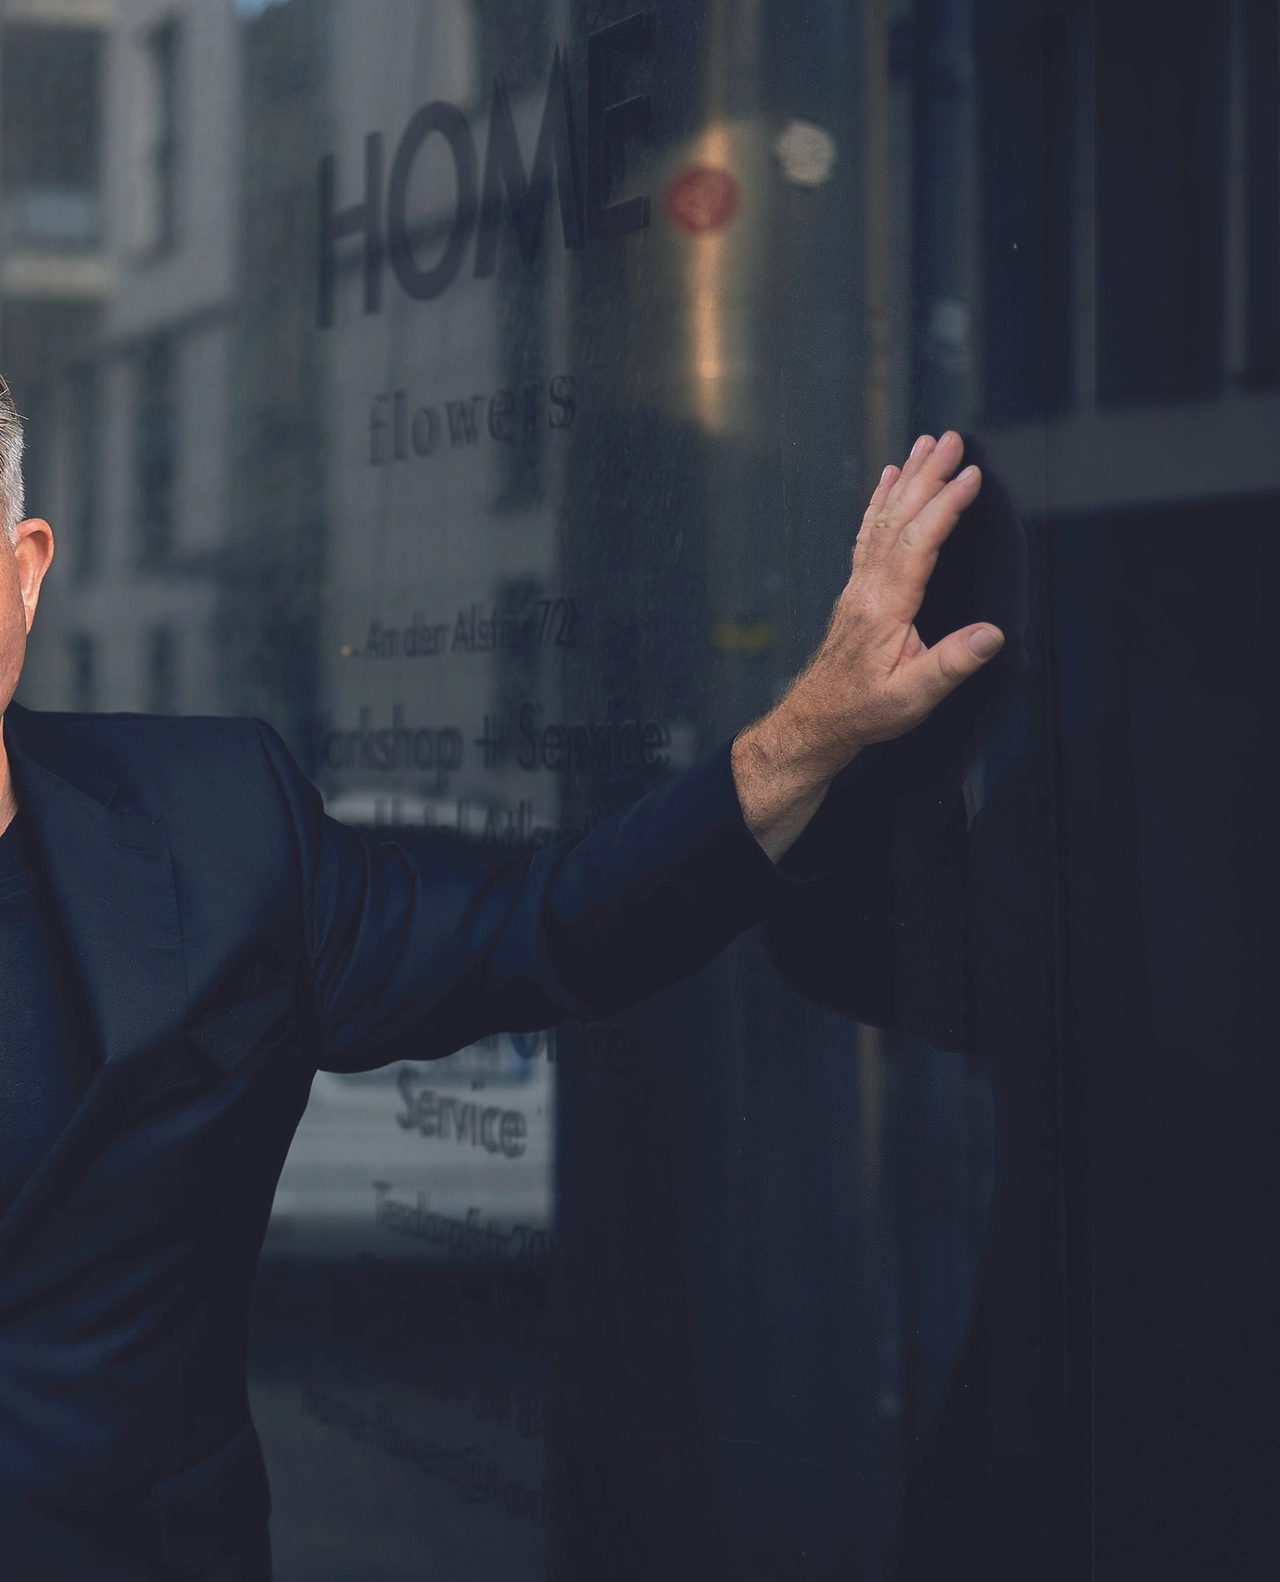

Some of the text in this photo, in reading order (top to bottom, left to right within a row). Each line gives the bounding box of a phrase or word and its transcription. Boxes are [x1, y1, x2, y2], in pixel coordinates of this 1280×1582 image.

[316, 8, 651, 330] HOME
[368, 374, 577, 468] flowers
[517, 702, 670, 772] Service
[396, 1064, 527, 1159] Service
